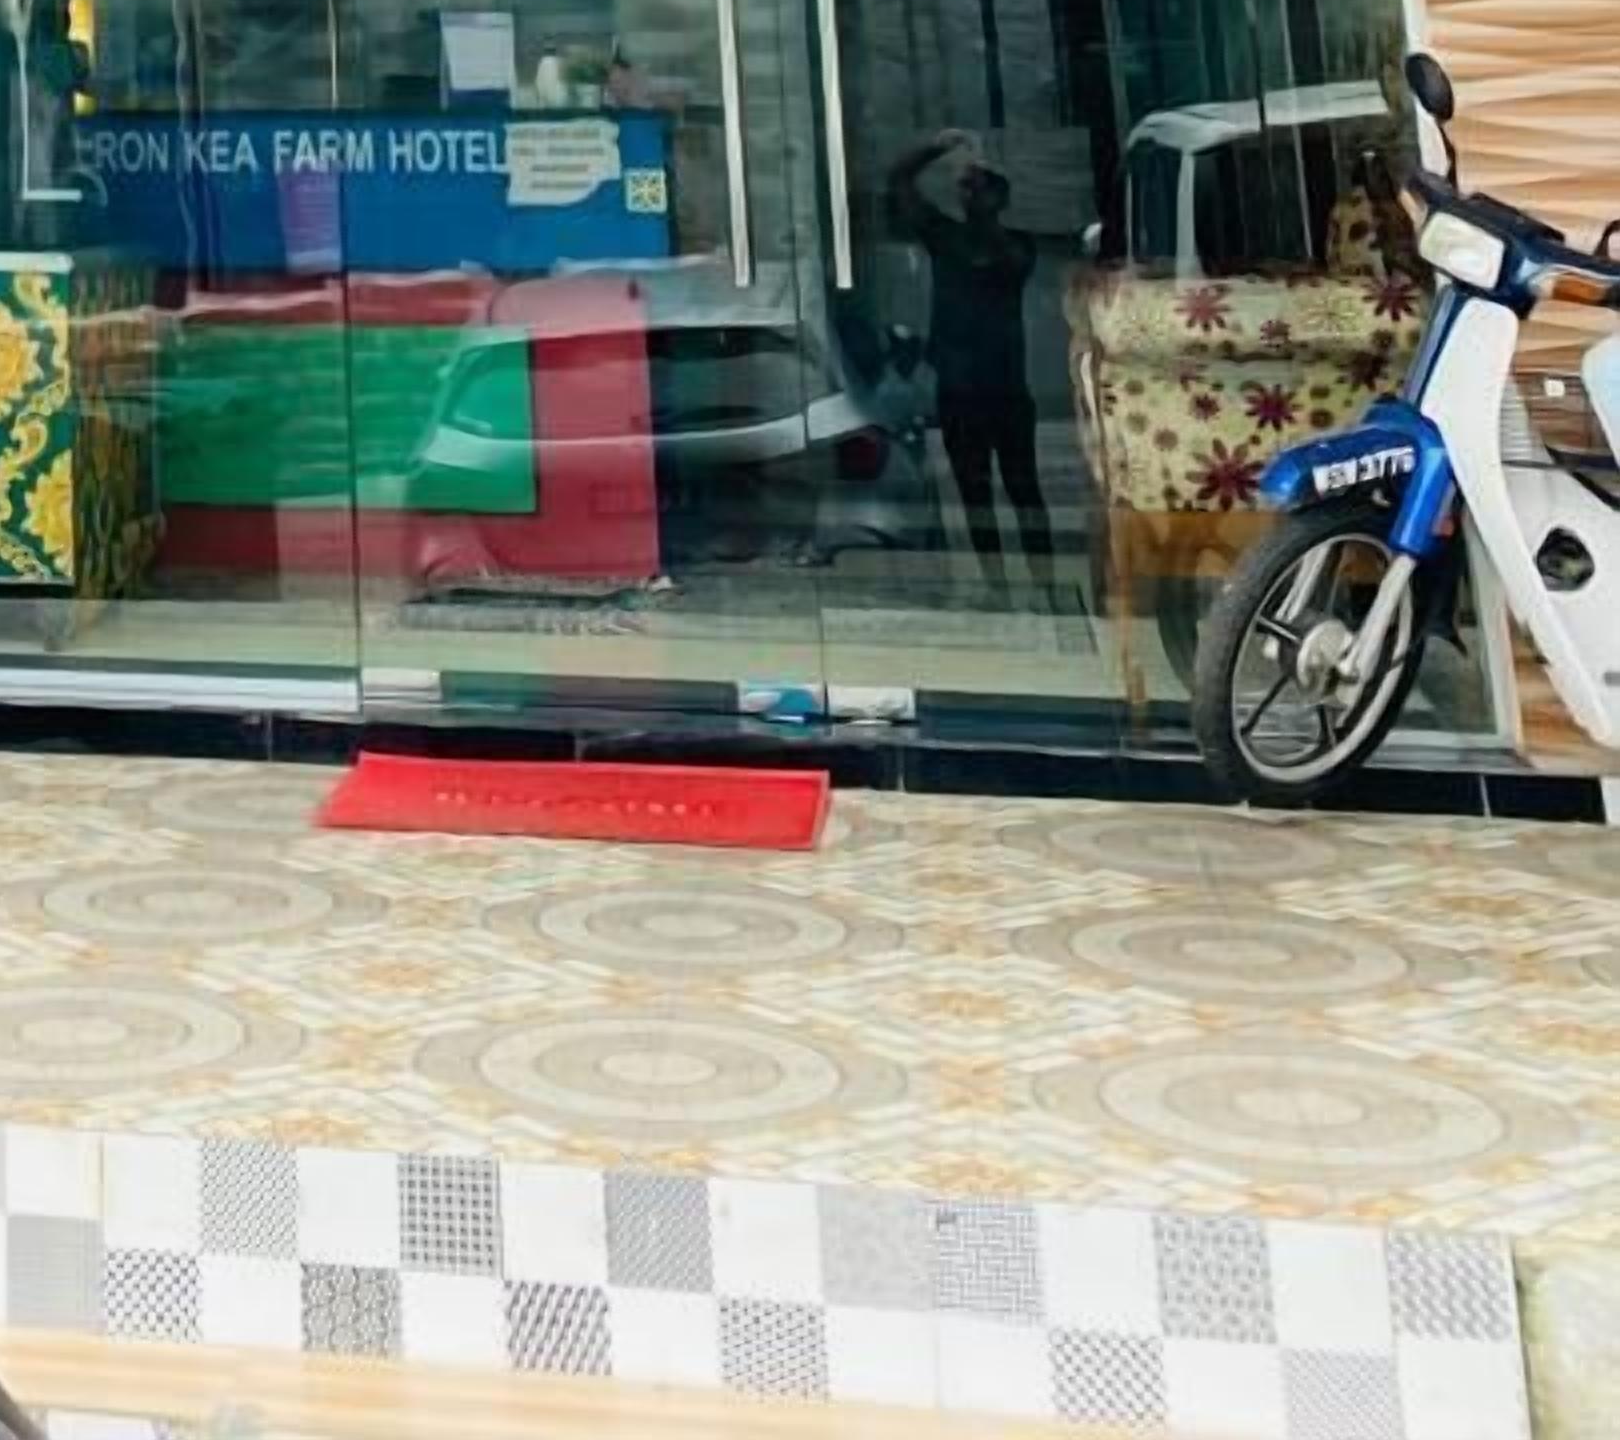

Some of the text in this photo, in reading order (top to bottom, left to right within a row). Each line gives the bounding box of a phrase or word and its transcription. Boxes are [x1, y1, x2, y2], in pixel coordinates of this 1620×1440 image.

[183, 130, 259, 173] KEA
[274, 129, 373, 174] FARM
[389, 130, 507, 174] HOTEL
